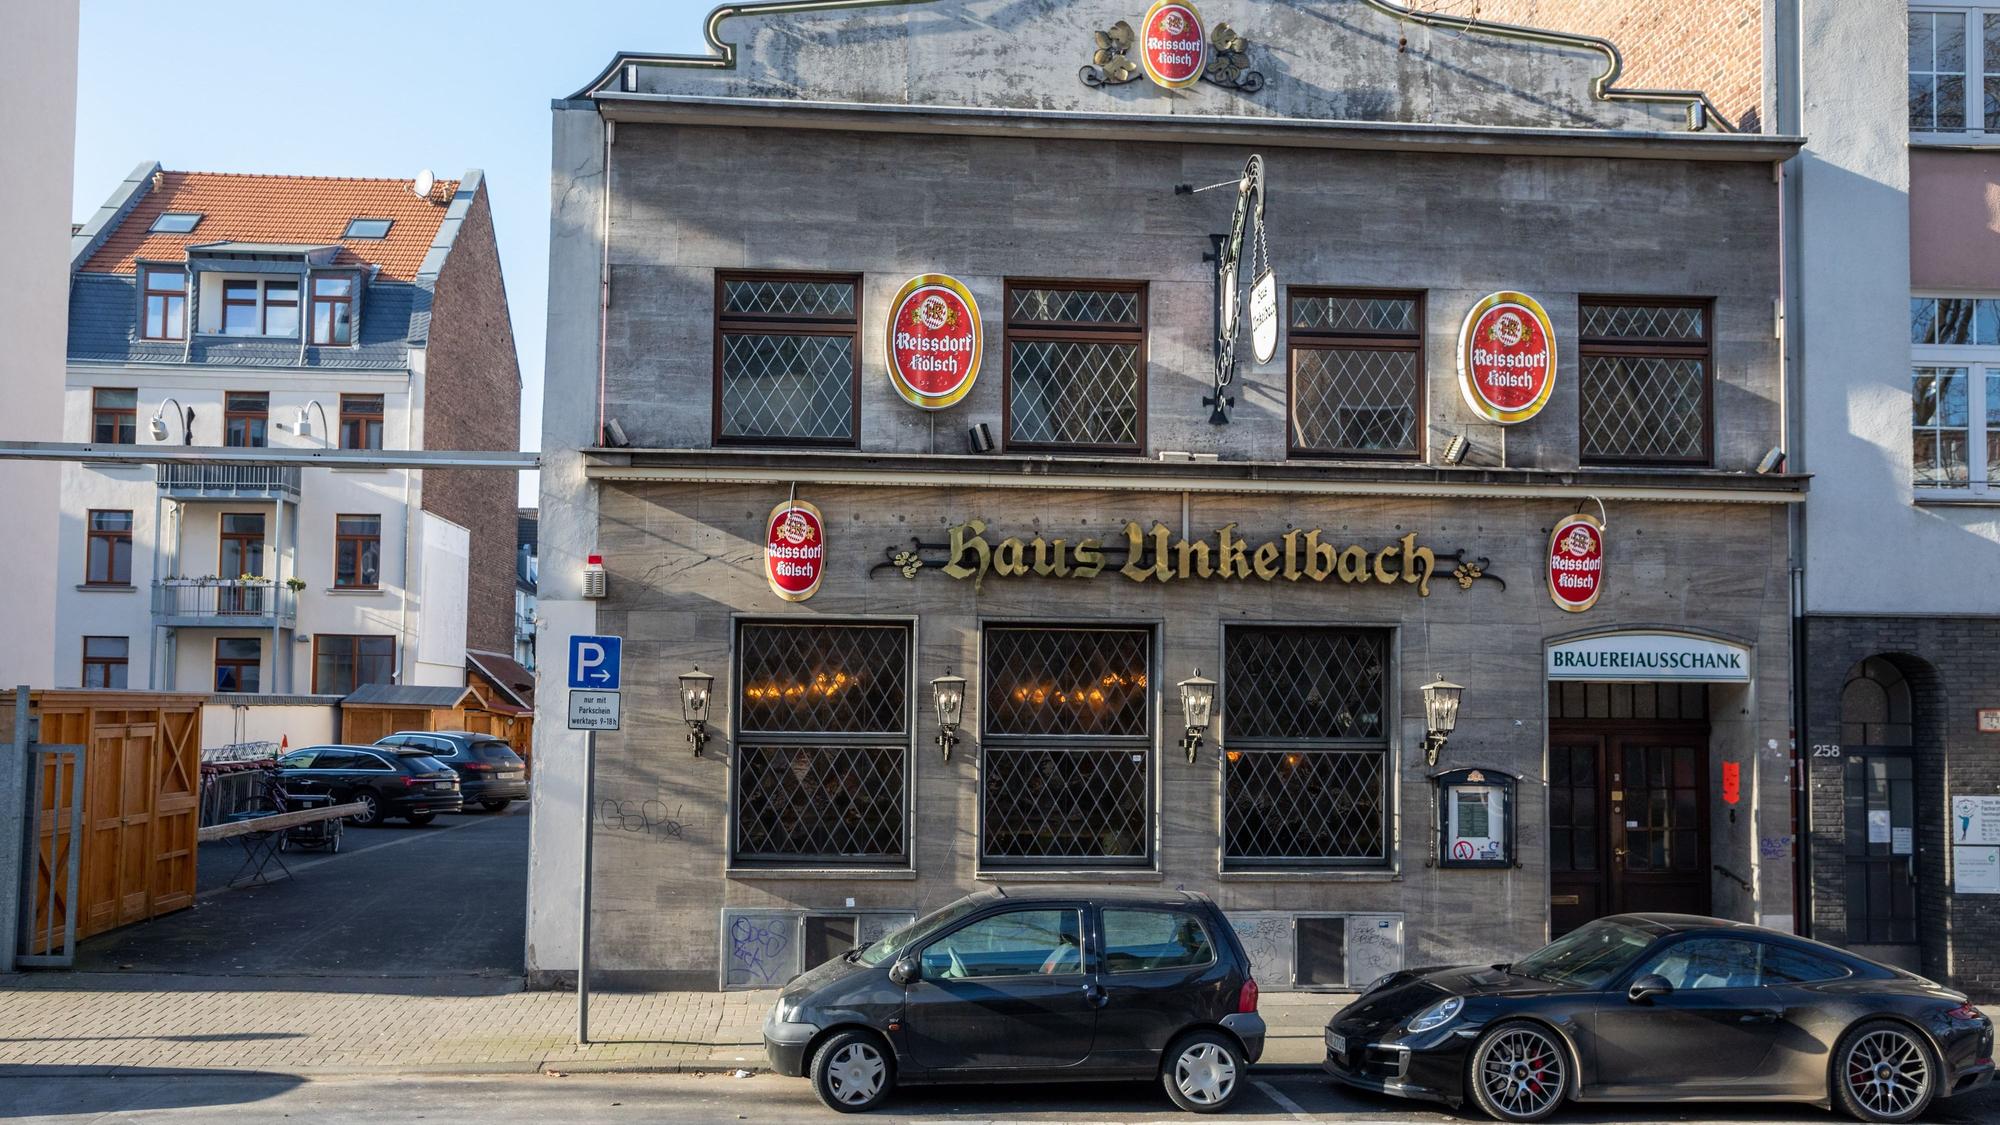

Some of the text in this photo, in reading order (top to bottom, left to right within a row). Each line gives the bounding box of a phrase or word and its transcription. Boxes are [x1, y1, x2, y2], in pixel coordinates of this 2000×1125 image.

[1148, 38, 1201, 52] Reissdorf
[1157, 52, 1192, 67] Kölsch
[896, 332, 973, 351] Reissdorf
[909, 354, 958, 375] Kölsch
[1473, 348, 1547, 368] Reissdorf
[1486, 369, 1533, 390] Kölsch
[769, 543, 821, 559] Reissdorf
[941, 519, 1436, 597] Haus Unkelbach
[776, 561, 813, 579] Kölsch
[1552, 555, 1601, 571] Reissdorf
[1558, 572, 1593, 589] Kölsch
[577, 642, 605, 682] P
[1553, 651, 1741, 669] BRAUEREIAUSSCHANK
[578, 706, 611, 715] Parkschein
[571, 717, 597, 726] werktags
[1812, 744, 1840, 757] 258
